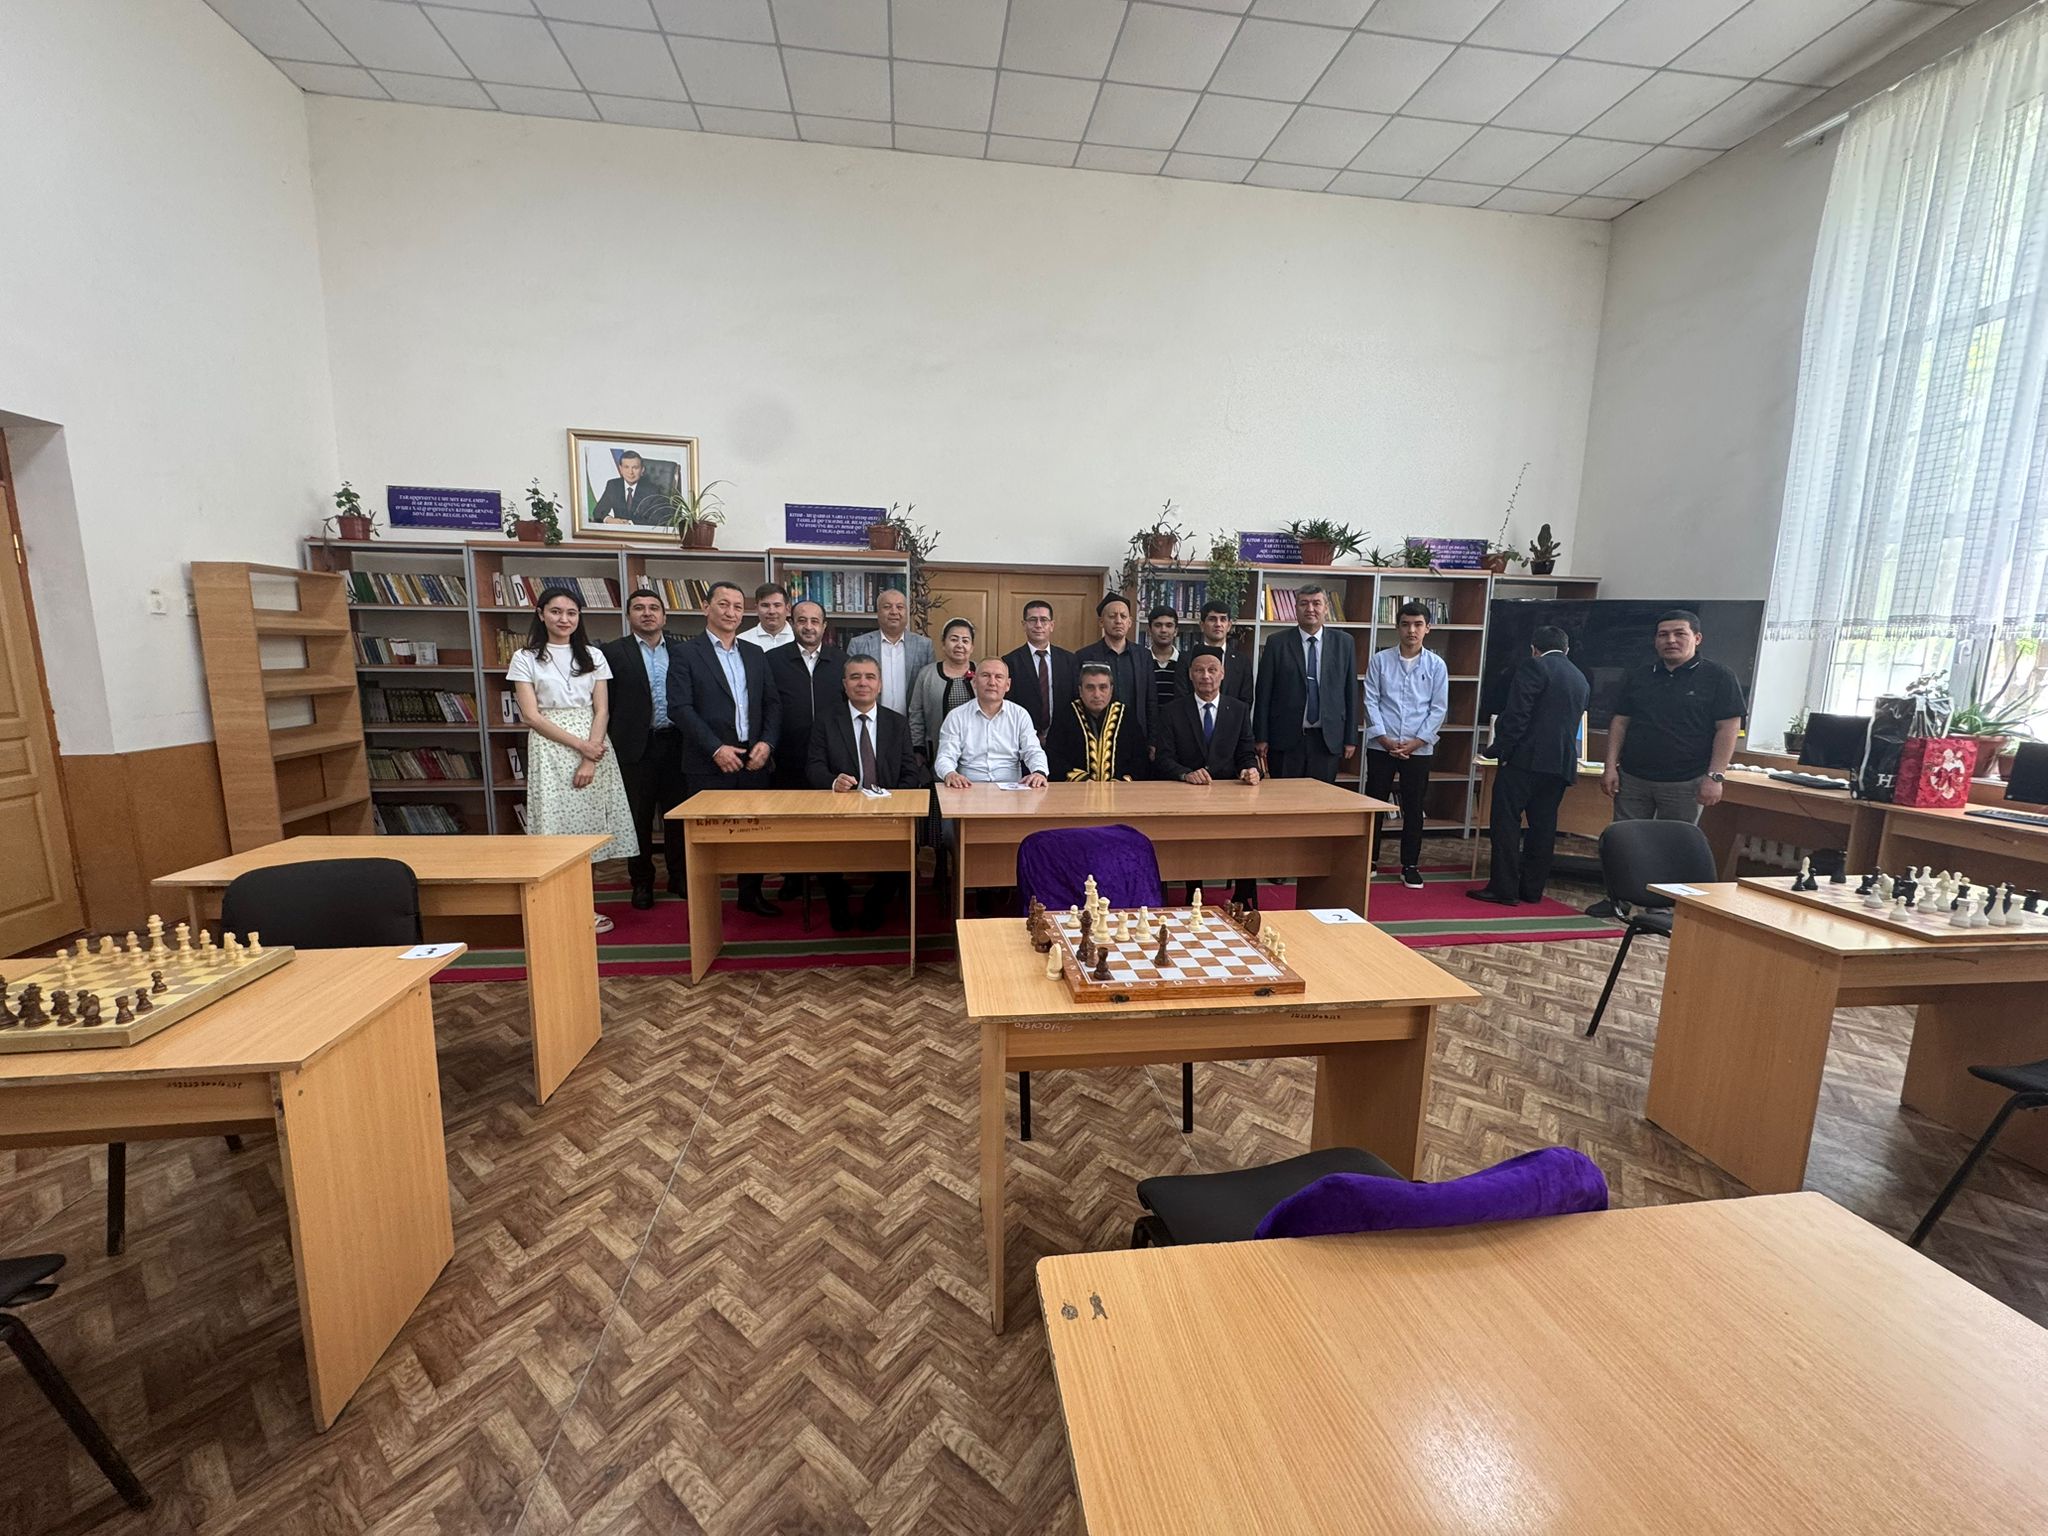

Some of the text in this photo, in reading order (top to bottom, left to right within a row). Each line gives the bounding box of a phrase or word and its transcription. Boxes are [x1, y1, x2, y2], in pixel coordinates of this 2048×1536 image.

[514, 582, 526, 601] D
[503, 699, 510, 718] J
[1331, 913, 1349, 921] 2
